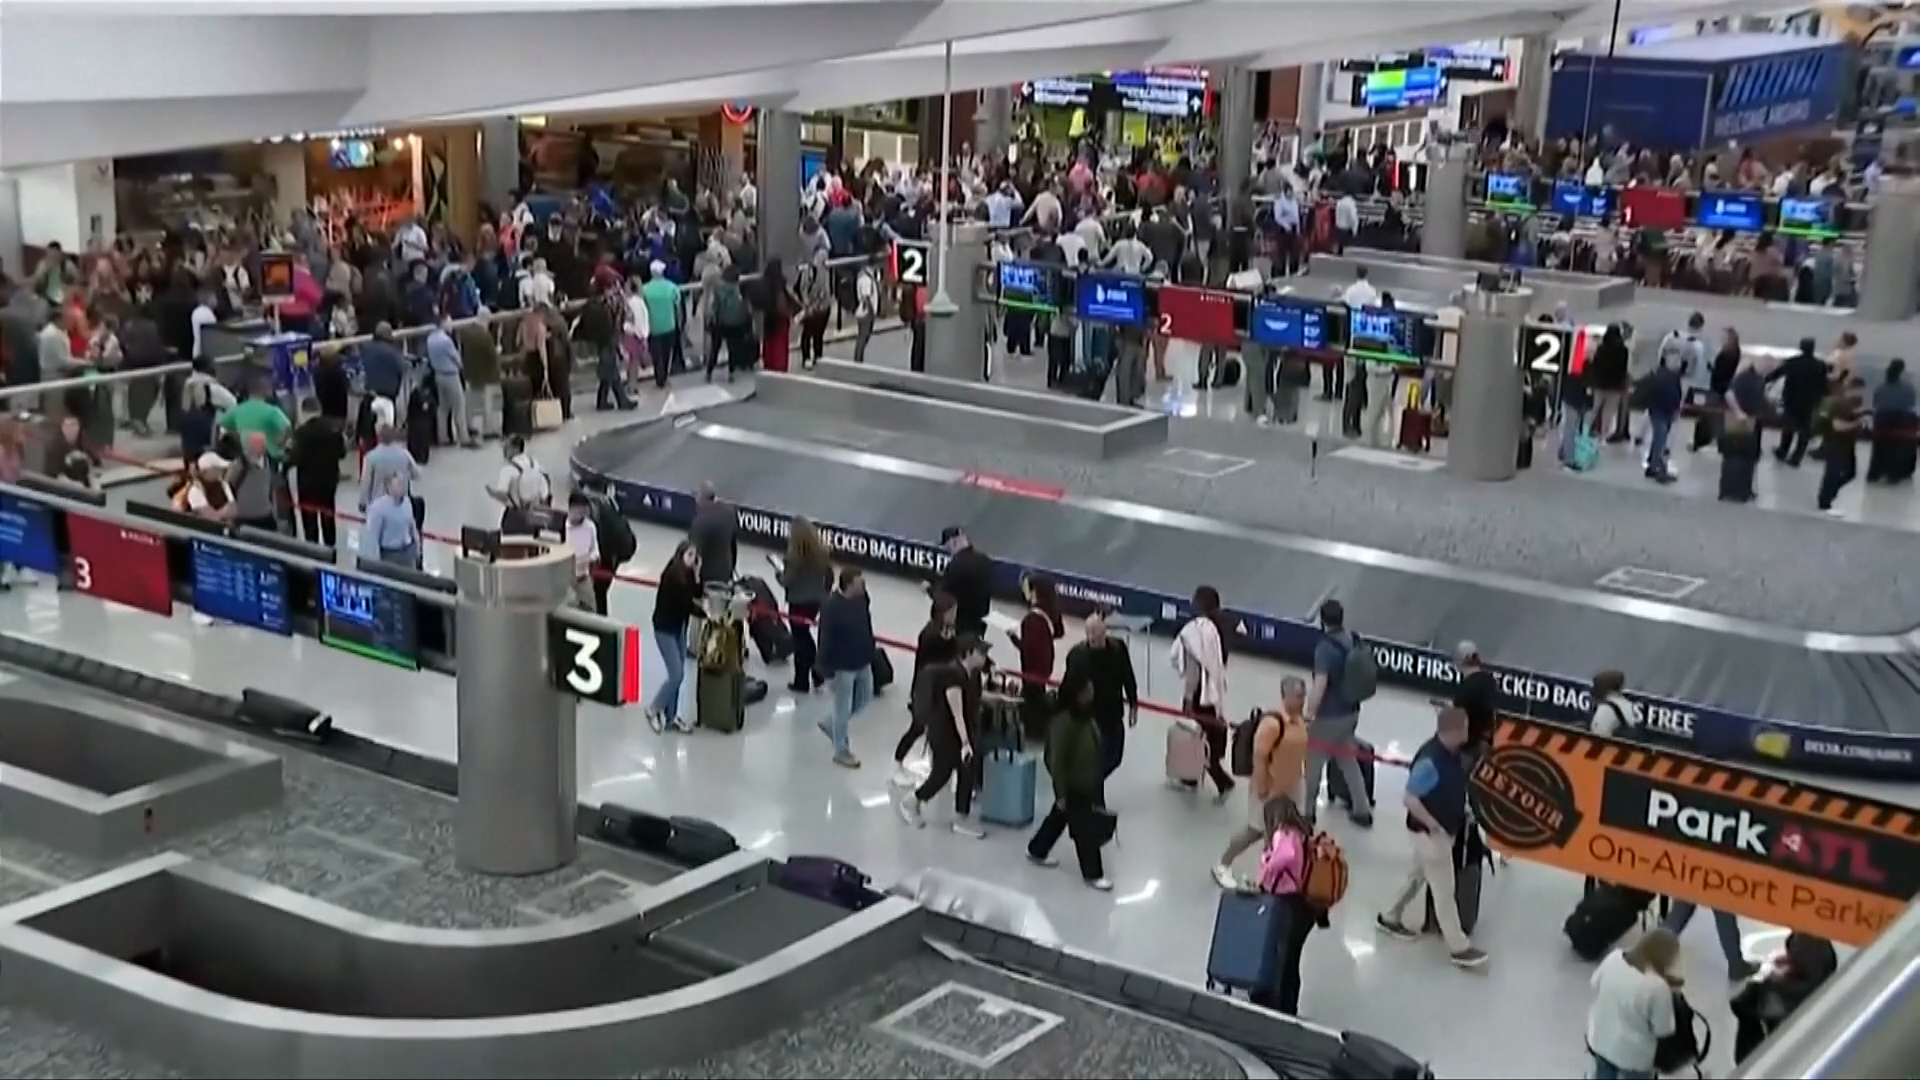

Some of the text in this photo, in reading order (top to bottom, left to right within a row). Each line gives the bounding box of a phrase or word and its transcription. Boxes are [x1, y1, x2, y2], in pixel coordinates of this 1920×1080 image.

[902, 248, 923, 283] 2
[1160, 313, 1172, 334] 2
[1531, 333, 1561, 373] 2
[737, 510, 771, 536] YOUR
[773, 520, 792, 538] FIR
[818, 528, 868, 554] HECKED
[869, 538, 897, 562] BAG
[900, 544, 934, 570] FLIES
[74, 556, 92, 590] 3
[565, 627, 603, 694] 3
[1373, 648, 1414, 675] OUR
[1552, 683, 1591, 712] BAG
[1648, 703, 1698, 734] FREE
[1478, 760, 1564, 830] DETOUR
[1647, 788, 1887, 883] Park ATL
[1589, 833, 1779, 906] On-Airport
